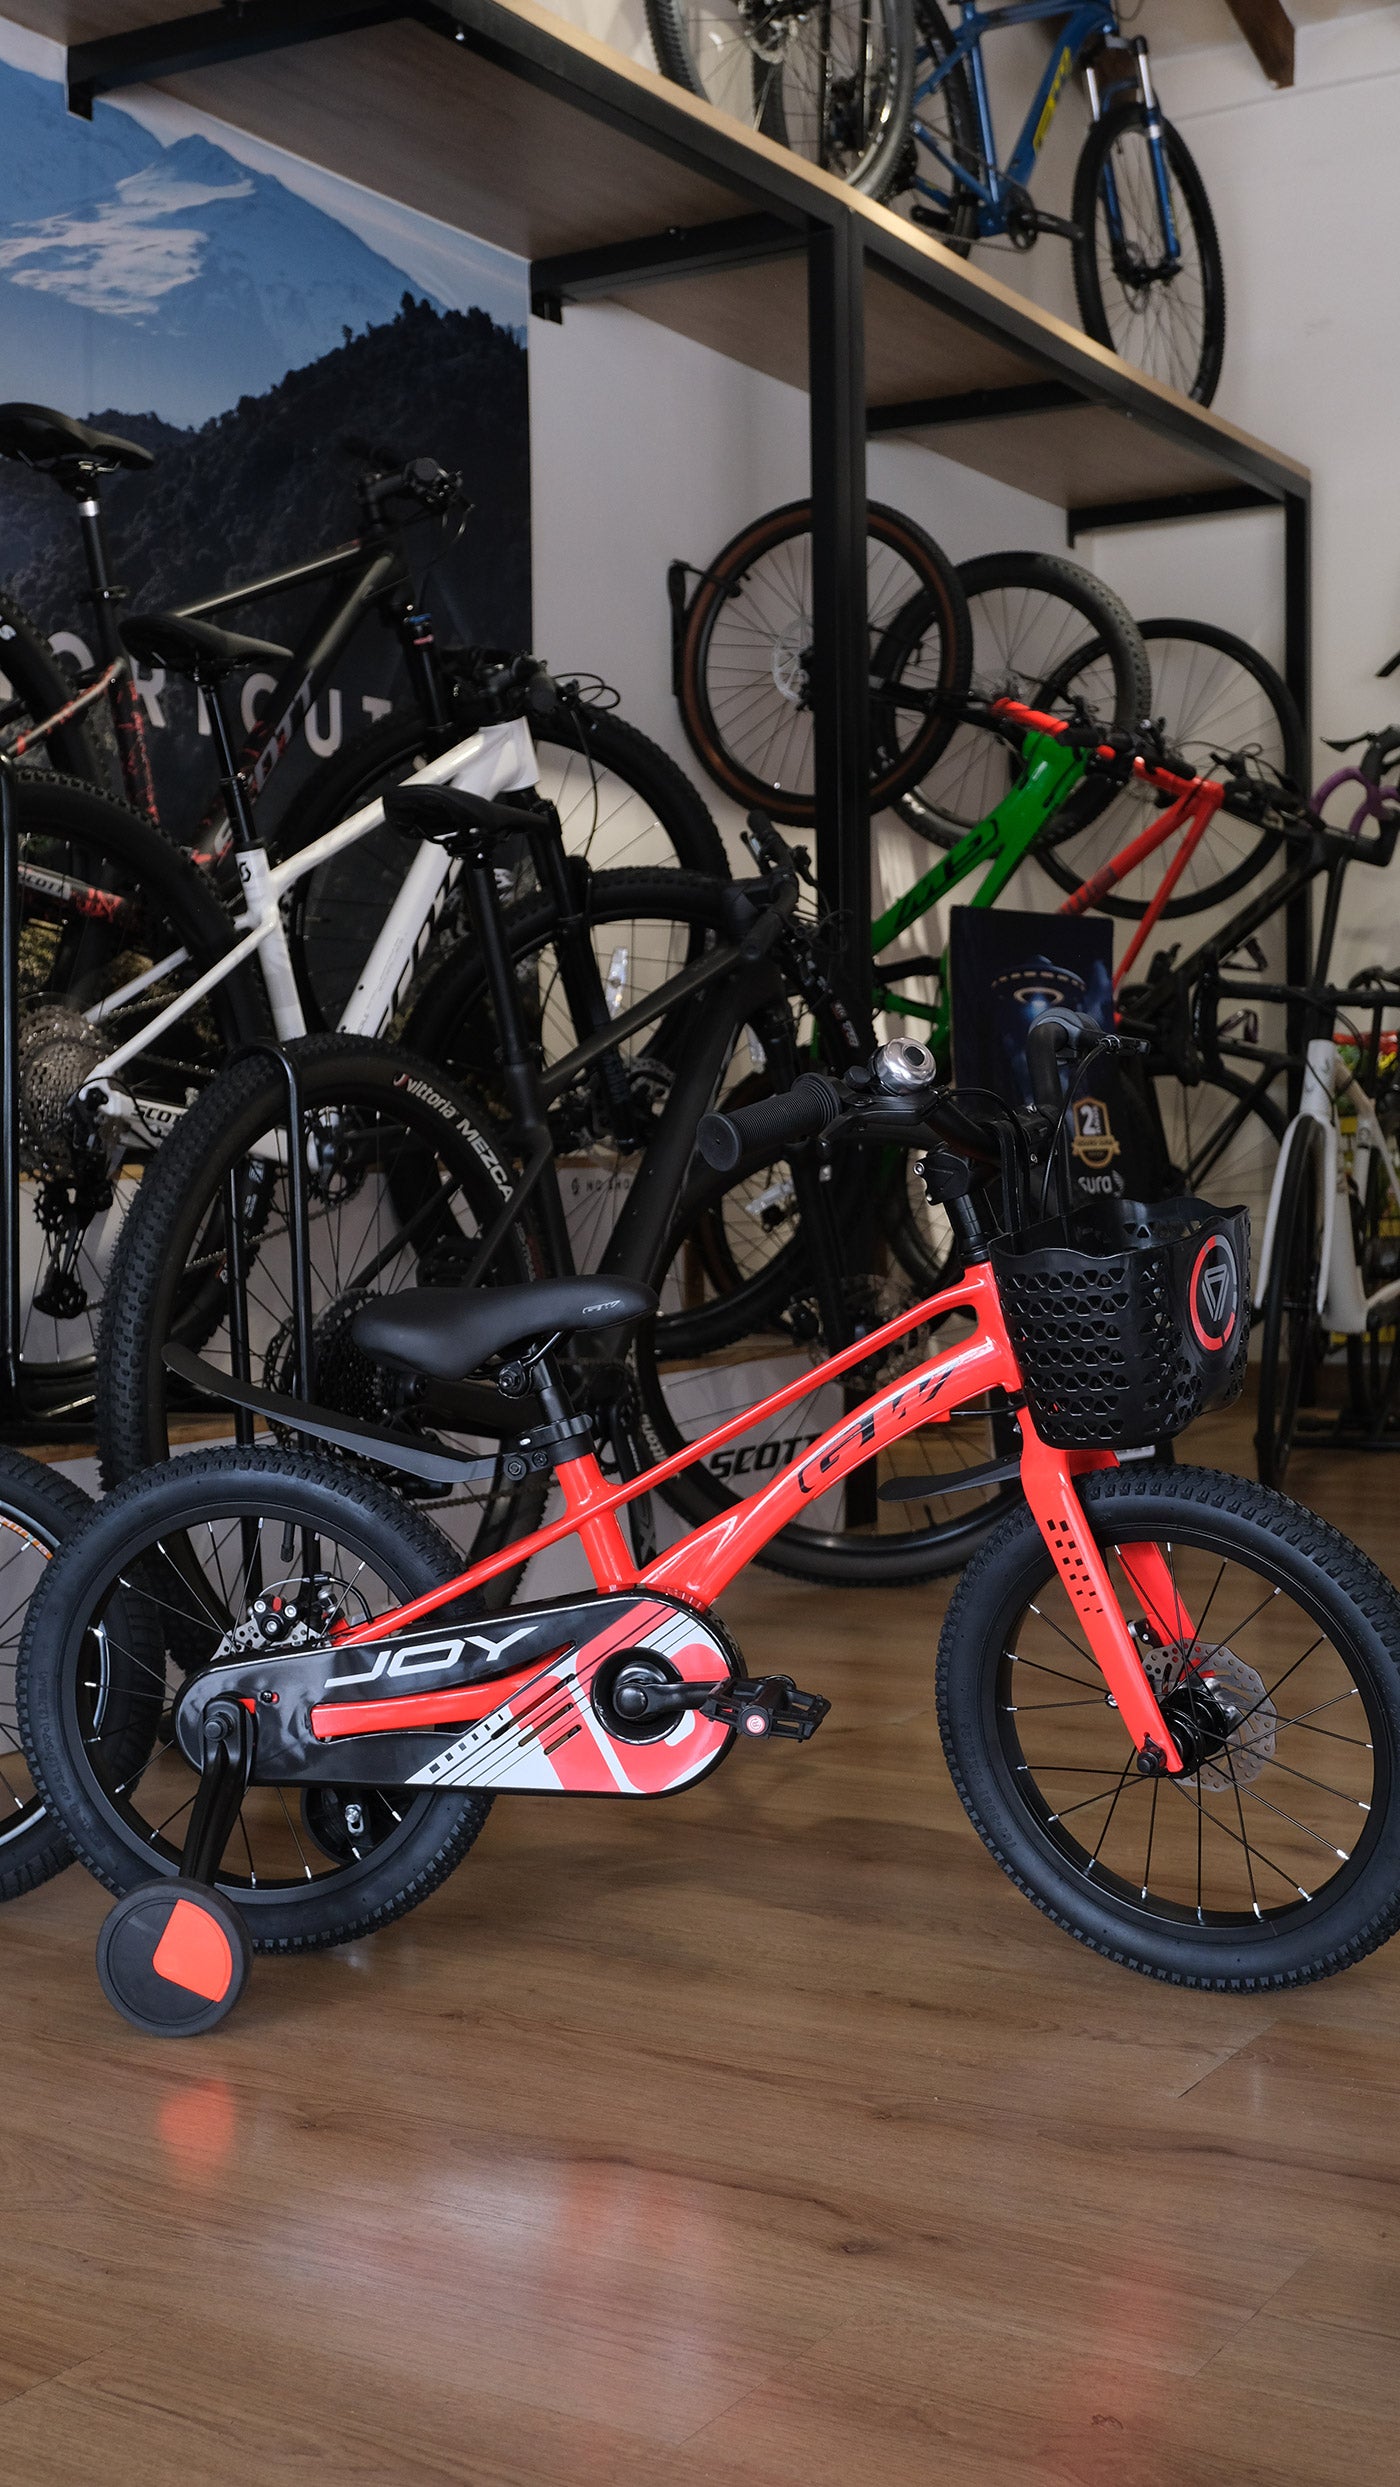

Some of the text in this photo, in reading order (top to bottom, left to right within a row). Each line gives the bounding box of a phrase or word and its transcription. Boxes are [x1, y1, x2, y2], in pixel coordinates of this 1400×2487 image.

[405, 1078, 458, 1119] vittoria
[456, 1117, 514, 1203] MEZCA
[1080, 1105, 1098, 1135] 2
[1078, 1175, 1112, 1194] sura
[324, 1625, 539, 1689] JOY
